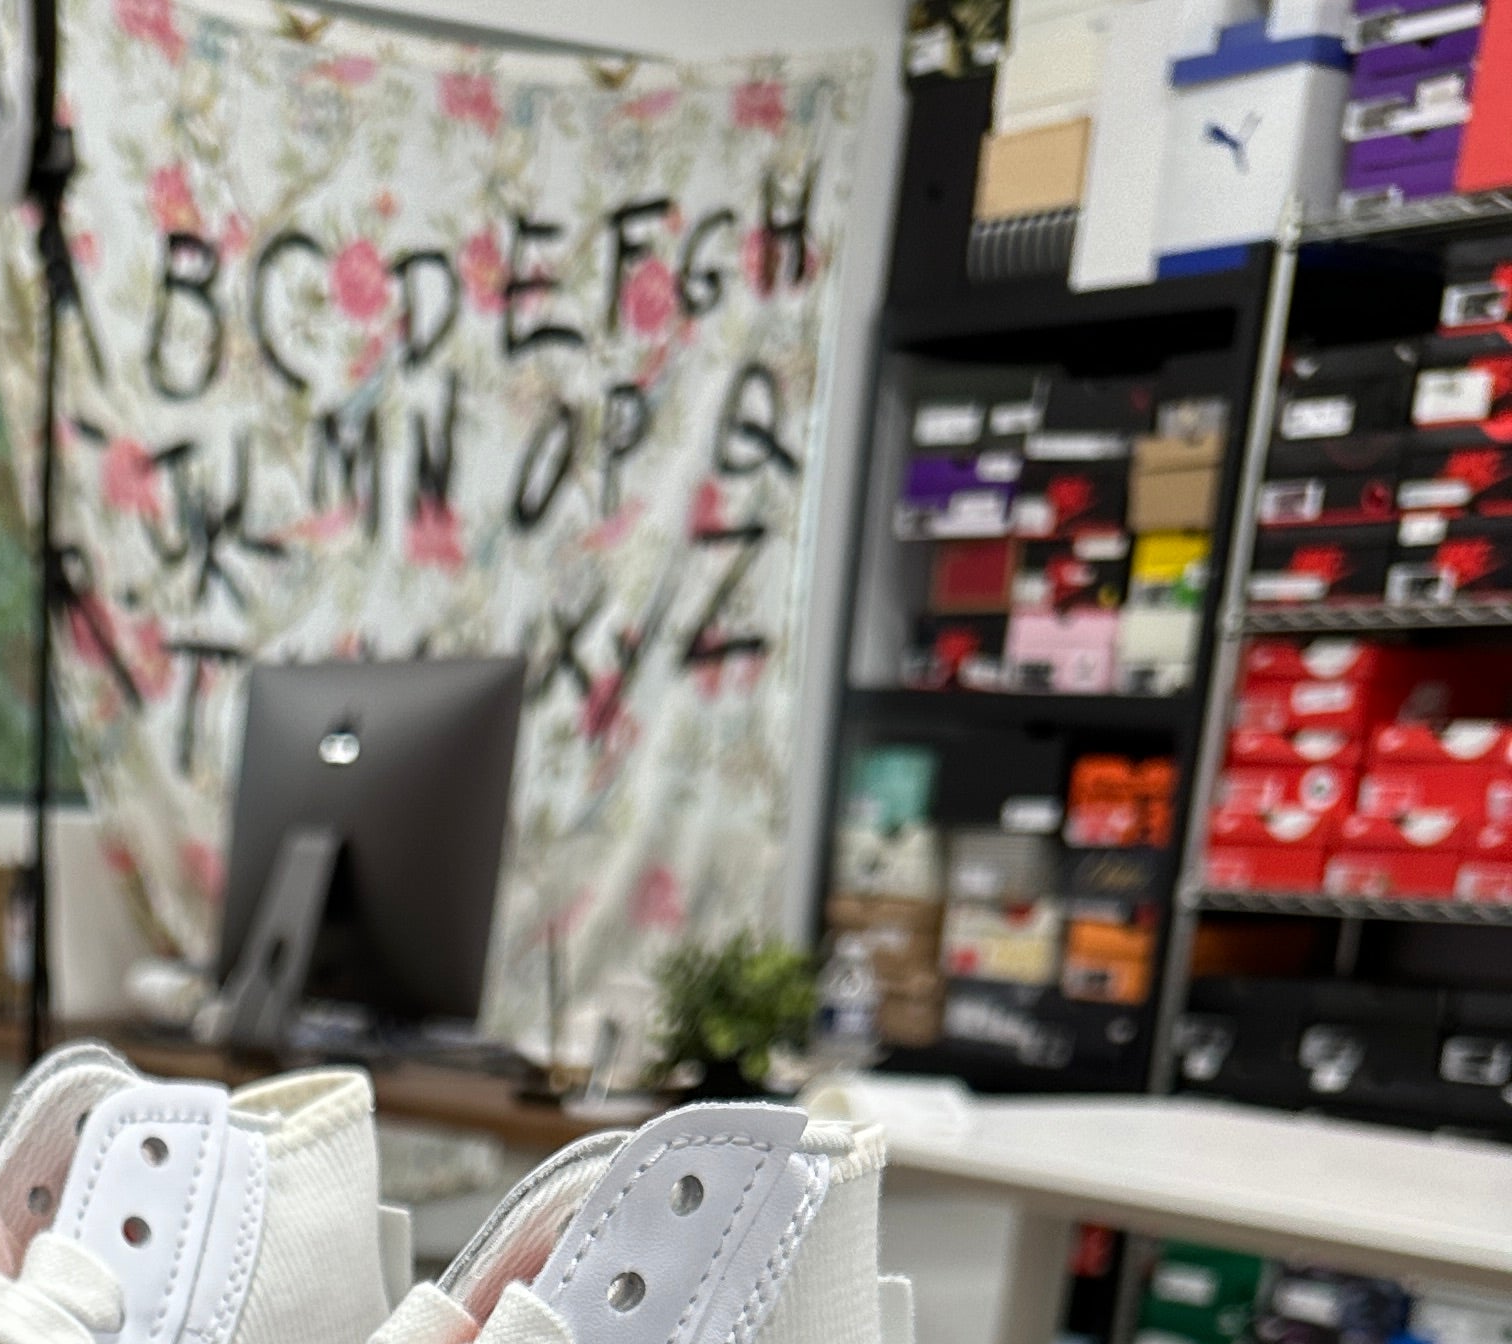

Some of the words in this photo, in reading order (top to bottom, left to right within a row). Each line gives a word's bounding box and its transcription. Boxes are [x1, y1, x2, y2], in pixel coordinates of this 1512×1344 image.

[145, 231, 225, 402] B
[392, 246, 460, 369] D
[503, 213, 584, 360] E
[605, 197, 674, 334] F
